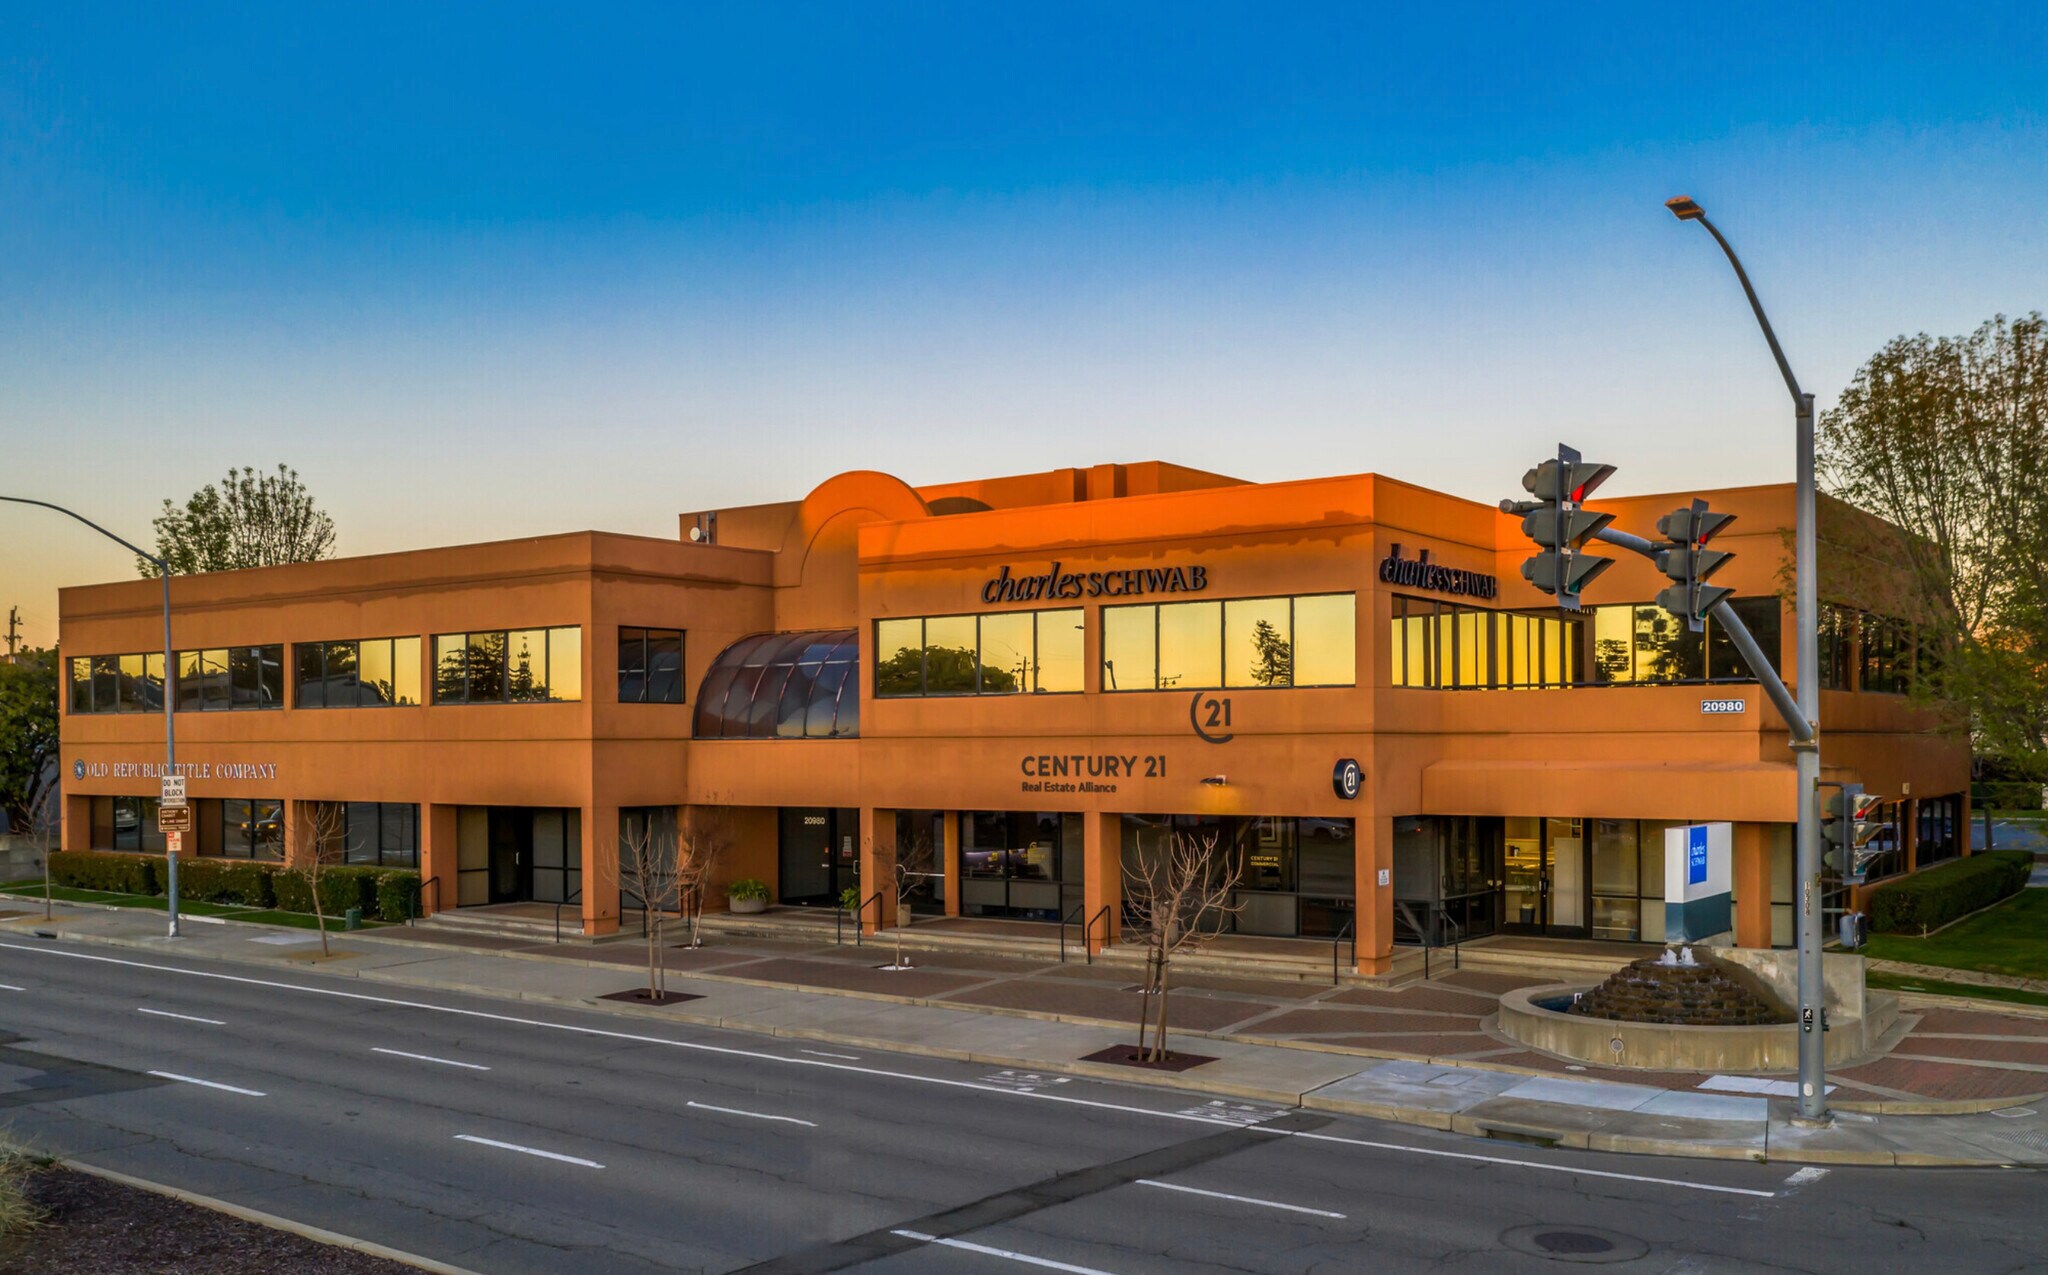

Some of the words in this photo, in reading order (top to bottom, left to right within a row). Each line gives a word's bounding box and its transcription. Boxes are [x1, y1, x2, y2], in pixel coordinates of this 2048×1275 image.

[1703, 701, 1743, 711] 20980
[86, 763, 109, 777] OLD
[113, 763, 169, 778] REPUBLIC
[174, 763, 210, 779] TITLE
[216, 763, 277, 780] COMPANY
[1021, 755, 1138, 778] CENTURY
[1144, 755, 1166, 778] 21
[163, 779, 171, 787] DO
[173, 779, 184, 787] NOT
[1021, 781, 1042, 792] Real
[1044, 782, 1076, 793] Estate
[1078, 782, 1117, 793] Alliance
[164, 788, 183, 797] BLOCK
